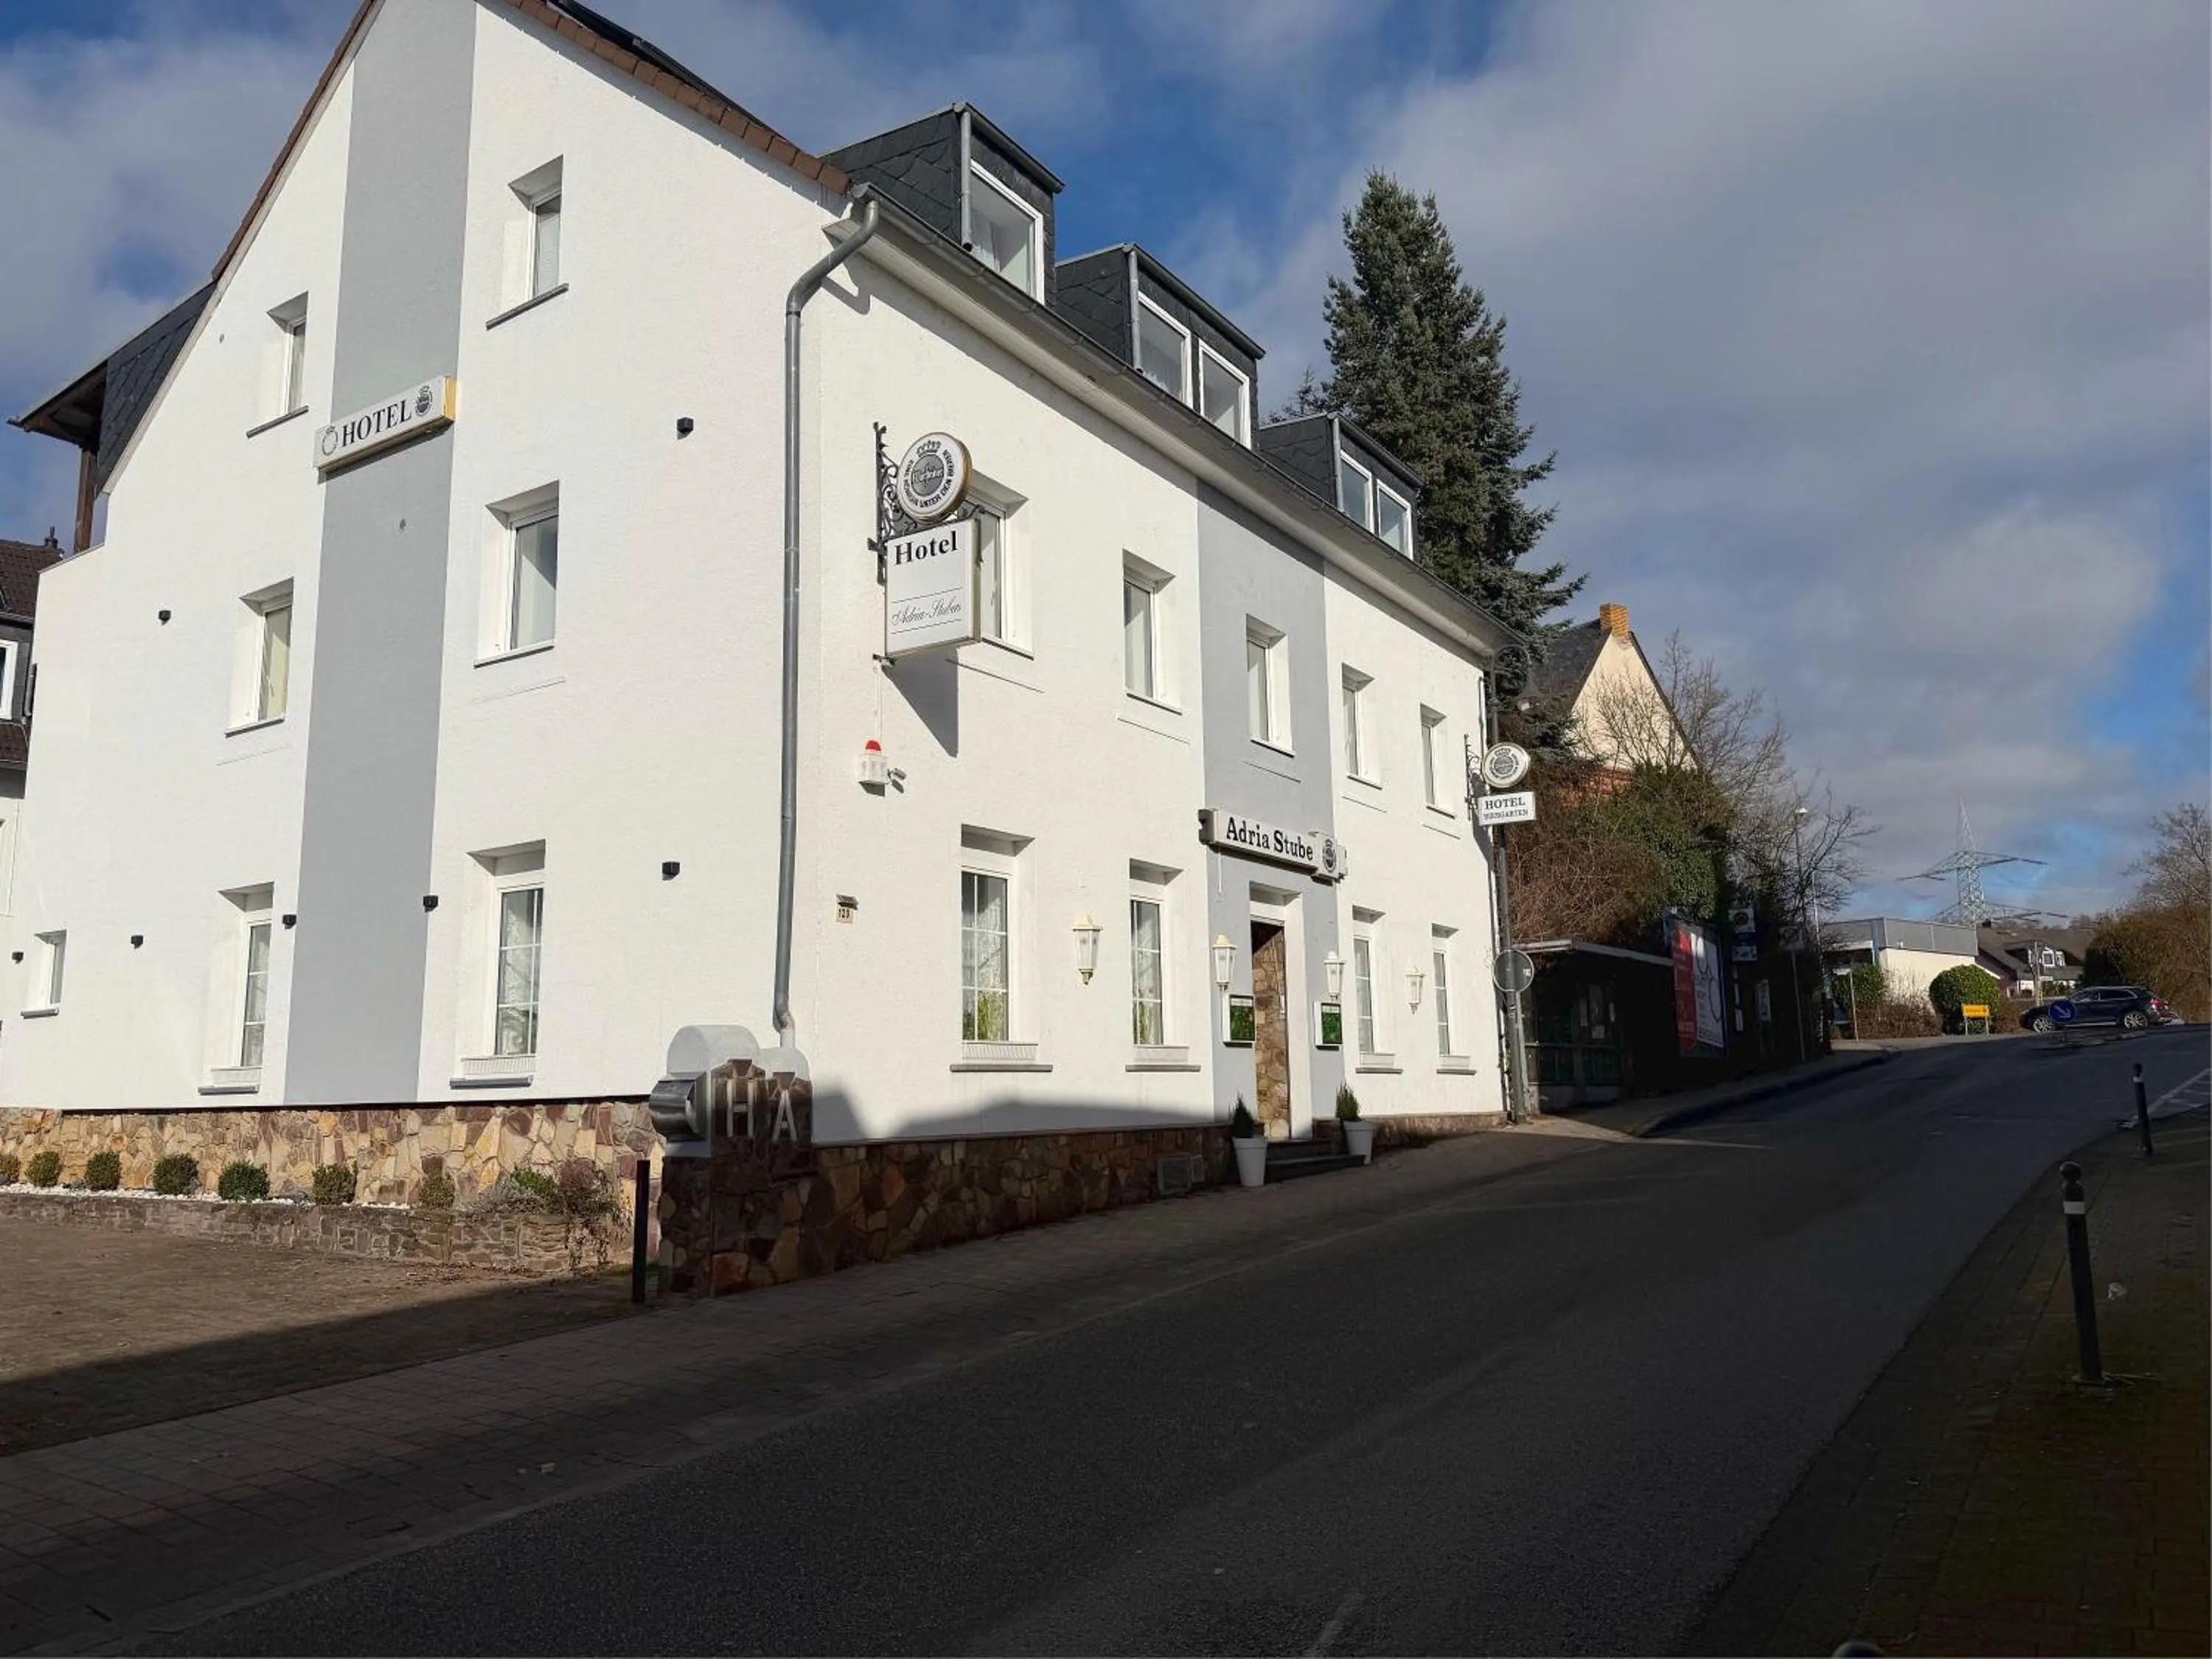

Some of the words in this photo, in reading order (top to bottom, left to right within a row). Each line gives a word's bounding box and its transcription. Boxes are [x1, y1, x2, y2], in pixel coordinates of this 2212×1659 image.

[341, 399, 412, 448] HOTEL
[894, 530, 959, 566] Hotel
[1484, 796, 1526, 810] HOTEL
[1226, 816, 1270, 850] Adria
[1273, 830, 1314, 861] Stube
